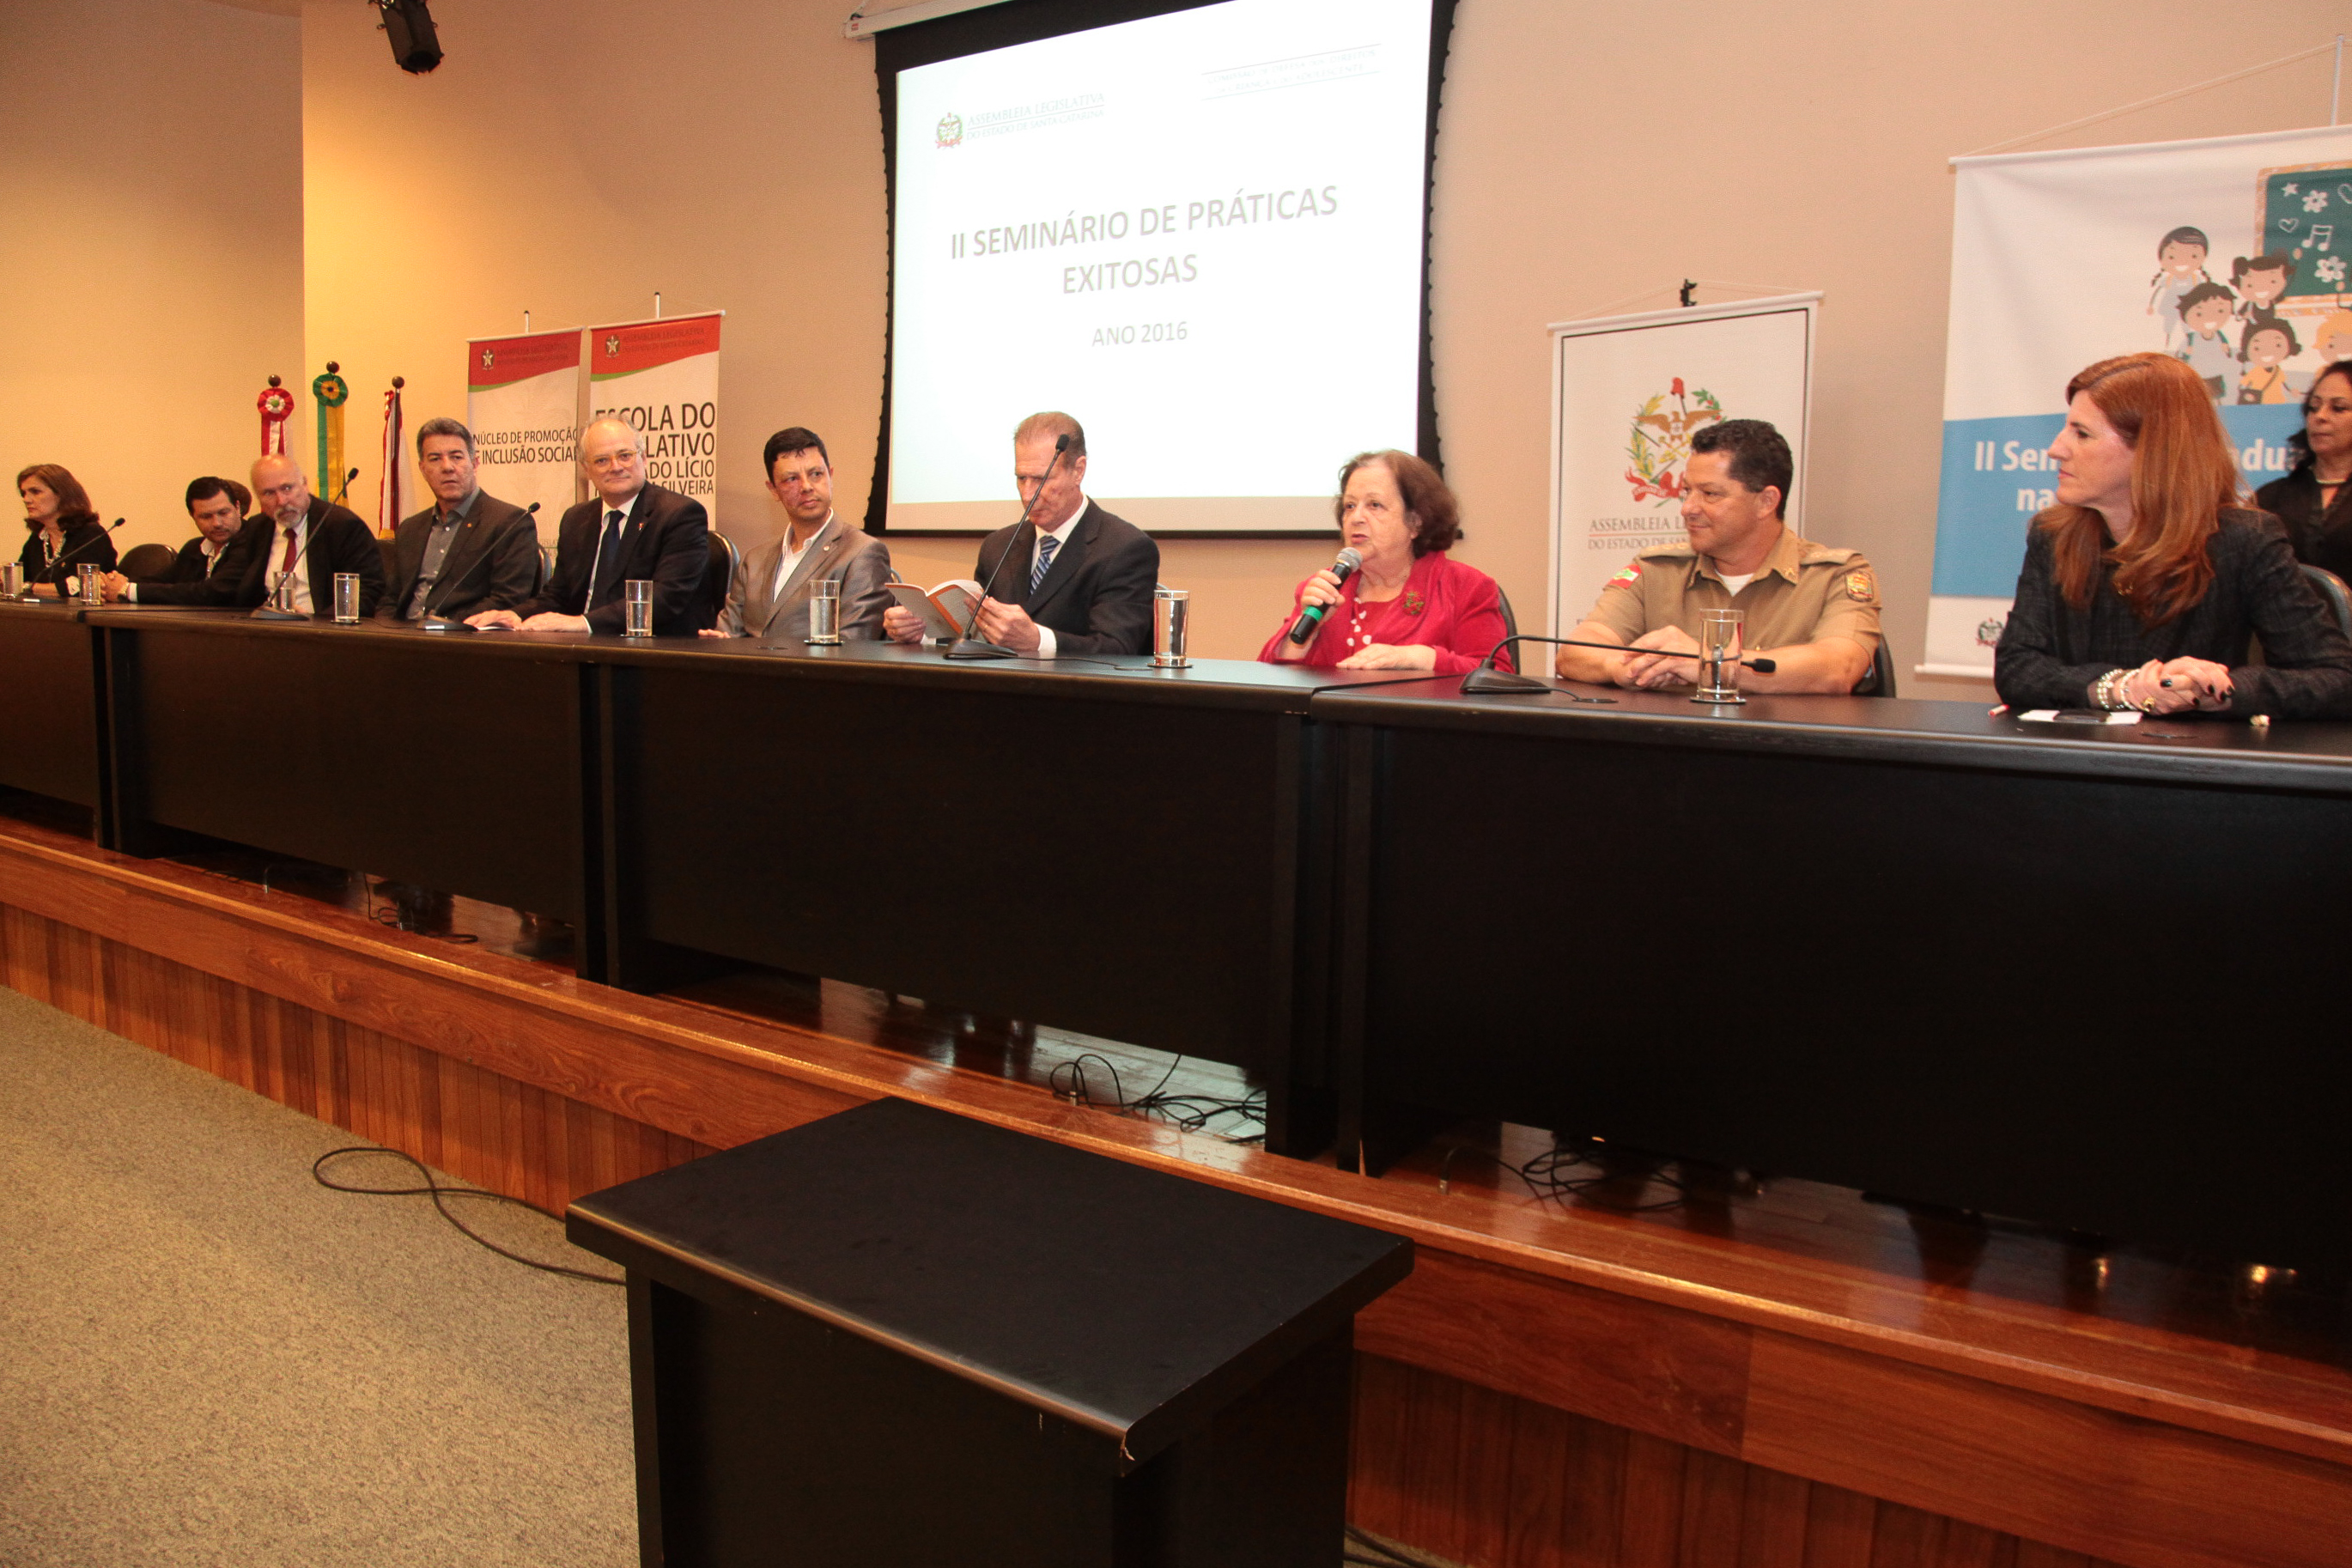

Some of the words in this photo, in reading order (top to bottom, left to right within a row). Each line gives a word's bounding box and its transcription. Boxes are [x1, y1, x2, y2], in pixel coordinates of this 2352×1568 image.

[968, 105, 1031, 126] ASSEMBLEIA
[1035, 93, 1105, 114] LEGISLATIVA
[967, 131, 981, 141] DO
[982, 126, 1015, 137] ESTADO
[1016, 123, 1029, 132] DE
[1030, 118, 1056, 129] SANTA
[1059, 109, 1105, 125] CATARINA
[951, 233, 964, 259] II
[973, 210, 1129, 257] SEMINÁRIO
[1140, 205, 1176, 236] DE
[1188, 185, 1338, 231] PRÁTICAS
[1063, 253, 1198, 294] EXITOSAS
[1091, 325, 1136, 347] ANO
[1140, 320, 1188, 343] 2016
[595, 404, 674, 431] OLA
[681, 402, 715, 428] DO
[472, 431, 508, 446] NÚCLEO
[510, 431, 522, 444] DE
[482, 445, 536, 465] INCLUSÃO
[677, 456, 714, 477] LÍCIO
[1975, 441, 1996, 471] II
[1589, 517, 1671, 532] ASSEMBLEIA
[1588, 538, 1606, 550] DO
[1607, 538, 1650, 550] ESTADO
